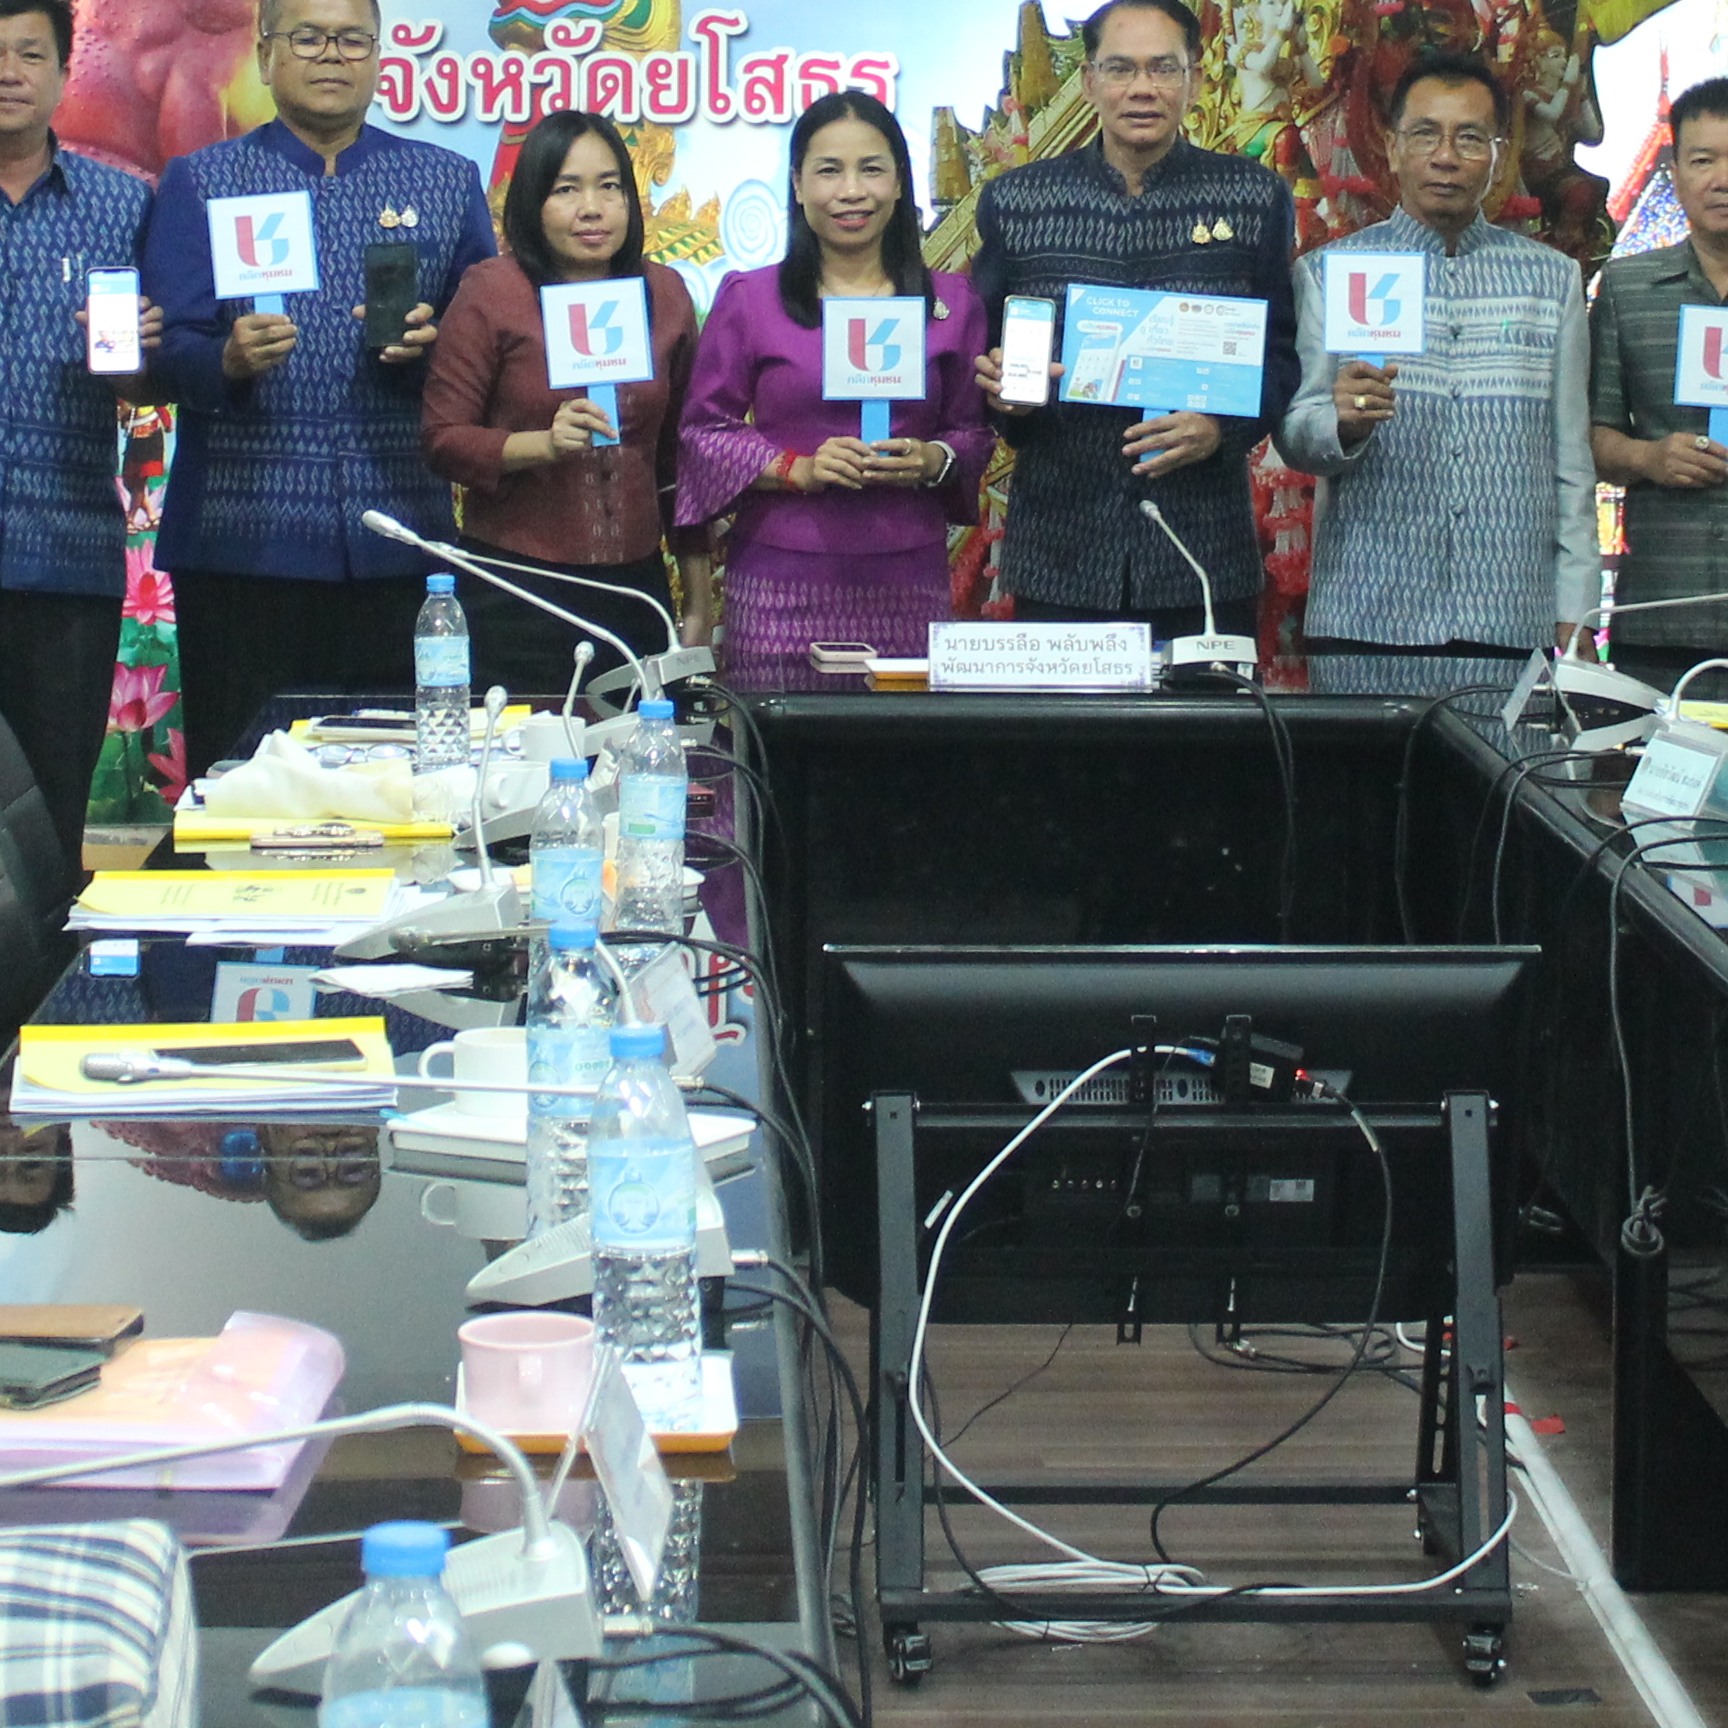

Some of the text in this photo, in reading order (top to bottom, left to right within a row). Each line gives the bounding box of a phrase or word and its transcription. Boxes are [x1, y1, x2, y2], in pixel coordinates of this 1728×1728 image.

[376, 13, 896, 118] จังหวัดยโสธร
[1092, 306, 1139, 318] CONNECT
[945, 633, 1127, 652] นายบรรลือ พลับพลึง
[1196, 641, 1235, 650] NPE
[941, 656, 1133, 675] พัฒนาการจังหวัดยโสธร
